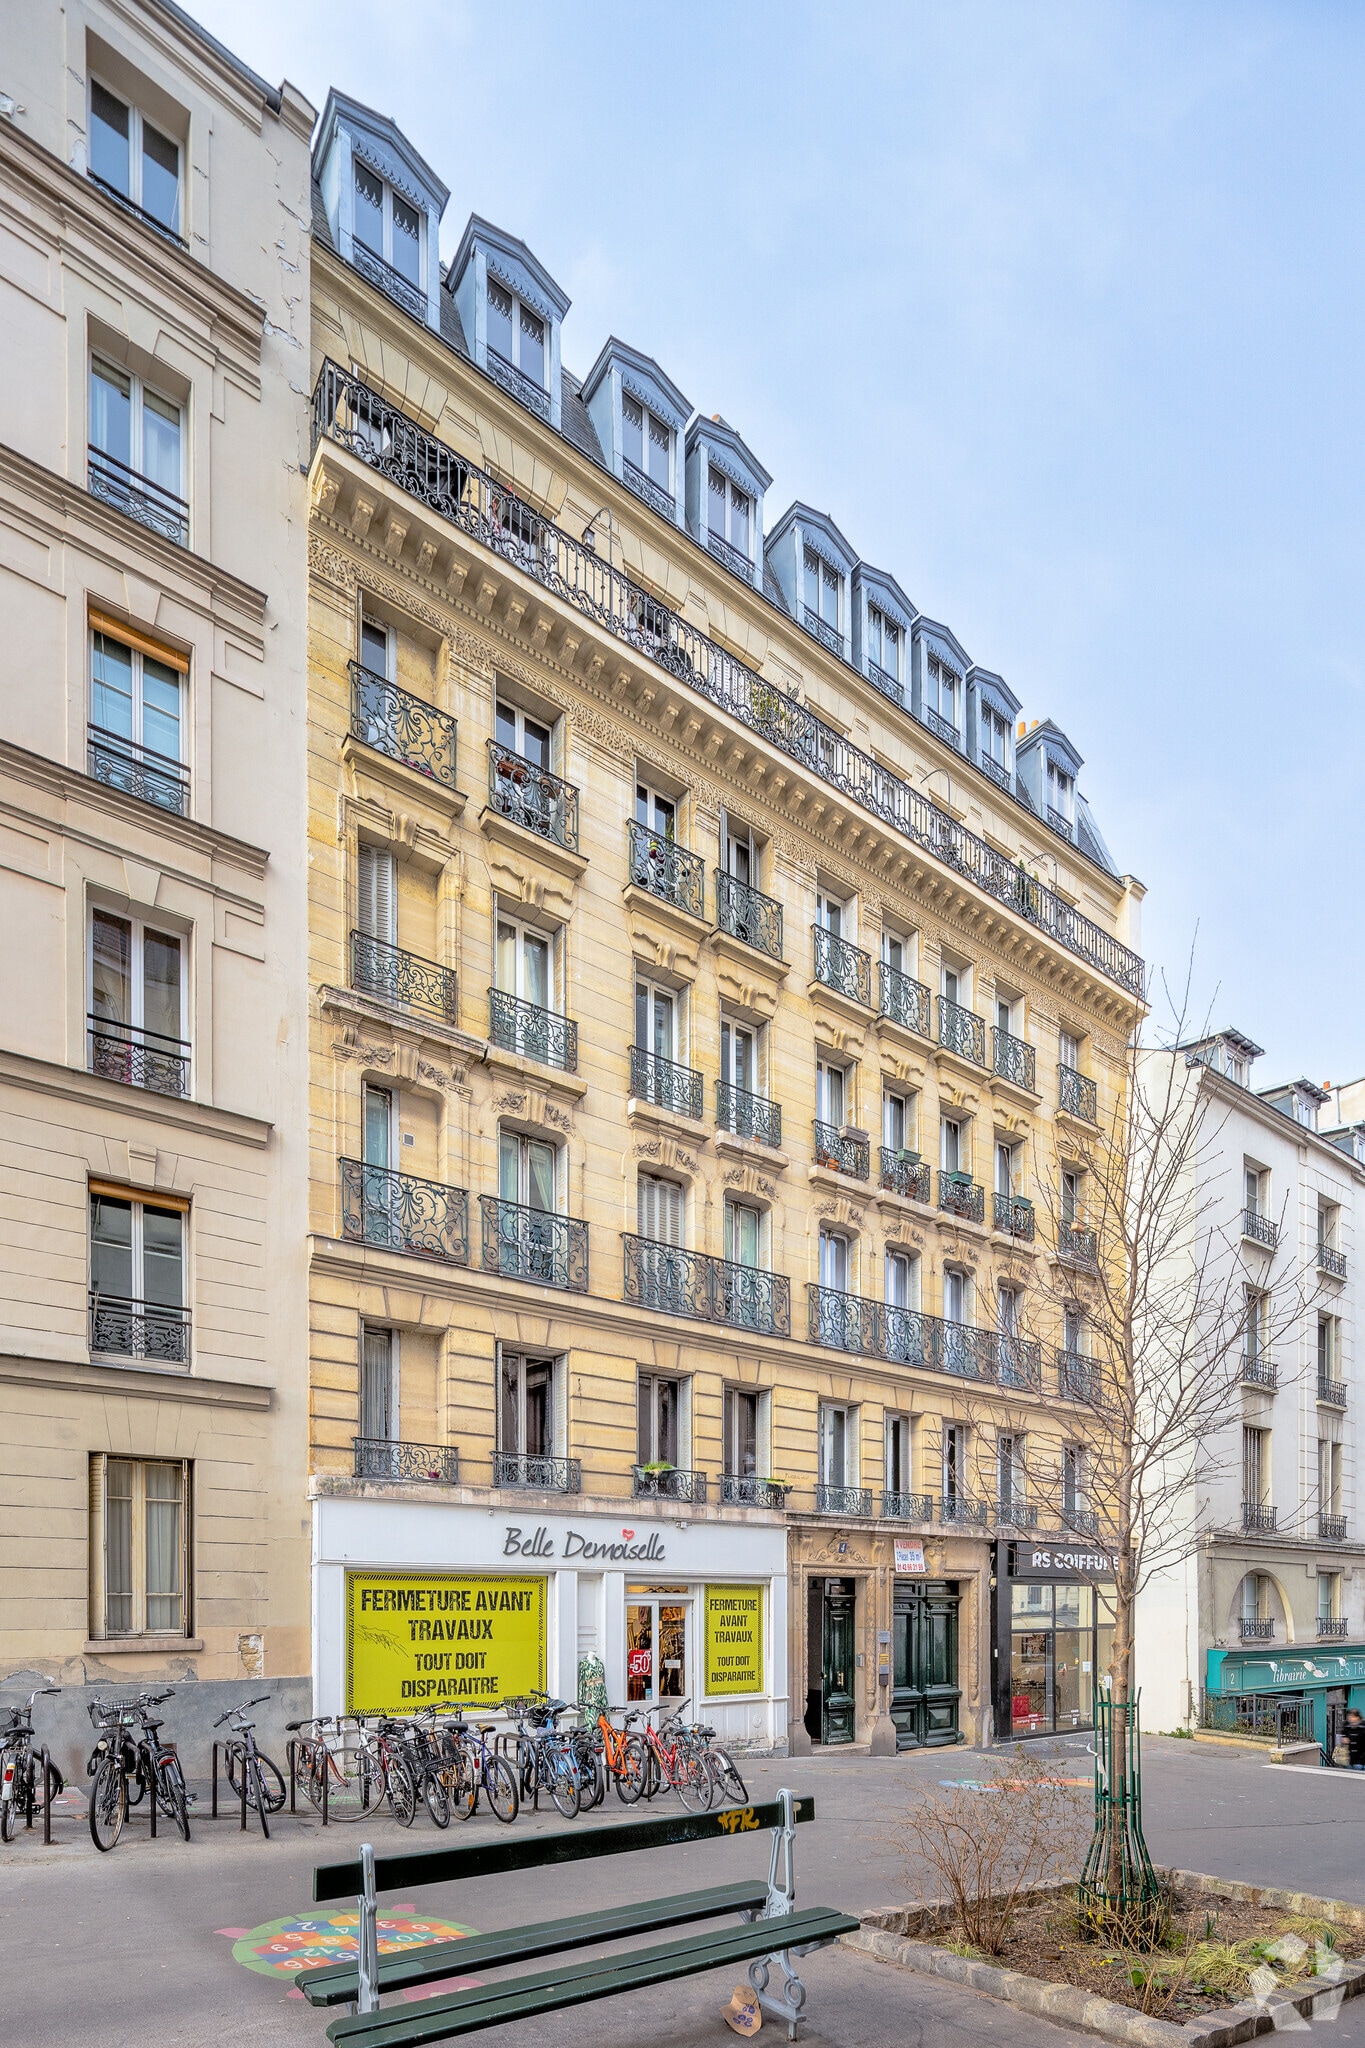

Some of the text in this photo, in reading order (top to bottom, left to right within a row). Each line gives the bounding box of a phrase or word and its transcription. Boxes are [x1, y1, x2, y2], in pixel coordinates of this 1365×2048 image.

[503, 1526, 665, 1560] Belle Demoiselle
[900, 1541, 922, 1549] VENDRE
[1032, 1552, 1050, 1568] RS
[361, 1589, 533, 1611] FERMETURE AVANT
[710, 1599, 757, 1610] FERMETURE
[720, 1615, 747, 1626] AVANT
[408, 1619, 493, 1641] TRAVAUX
[715, 1631, 752, 1643] TRAVAUX
[414, 1652, 487, 1671] TOUT DOIT
[717, 1656, 750, 1666] TOUT DOIT
[1335, 1662, 1365, 1676] LES TR
[711, 1671, 755, 1682] DISPARAITRE
[1230, 1673, 1235, 1684] 2
[1273, 1668, 1307, 1683] librairie
[401, 1676, 498, 1698] DISPARAITRE
[297, 1921, 317, 1931] 2
[285, 1933, 304, 1941] 5
[321, 1937, 340, 1945] 8
